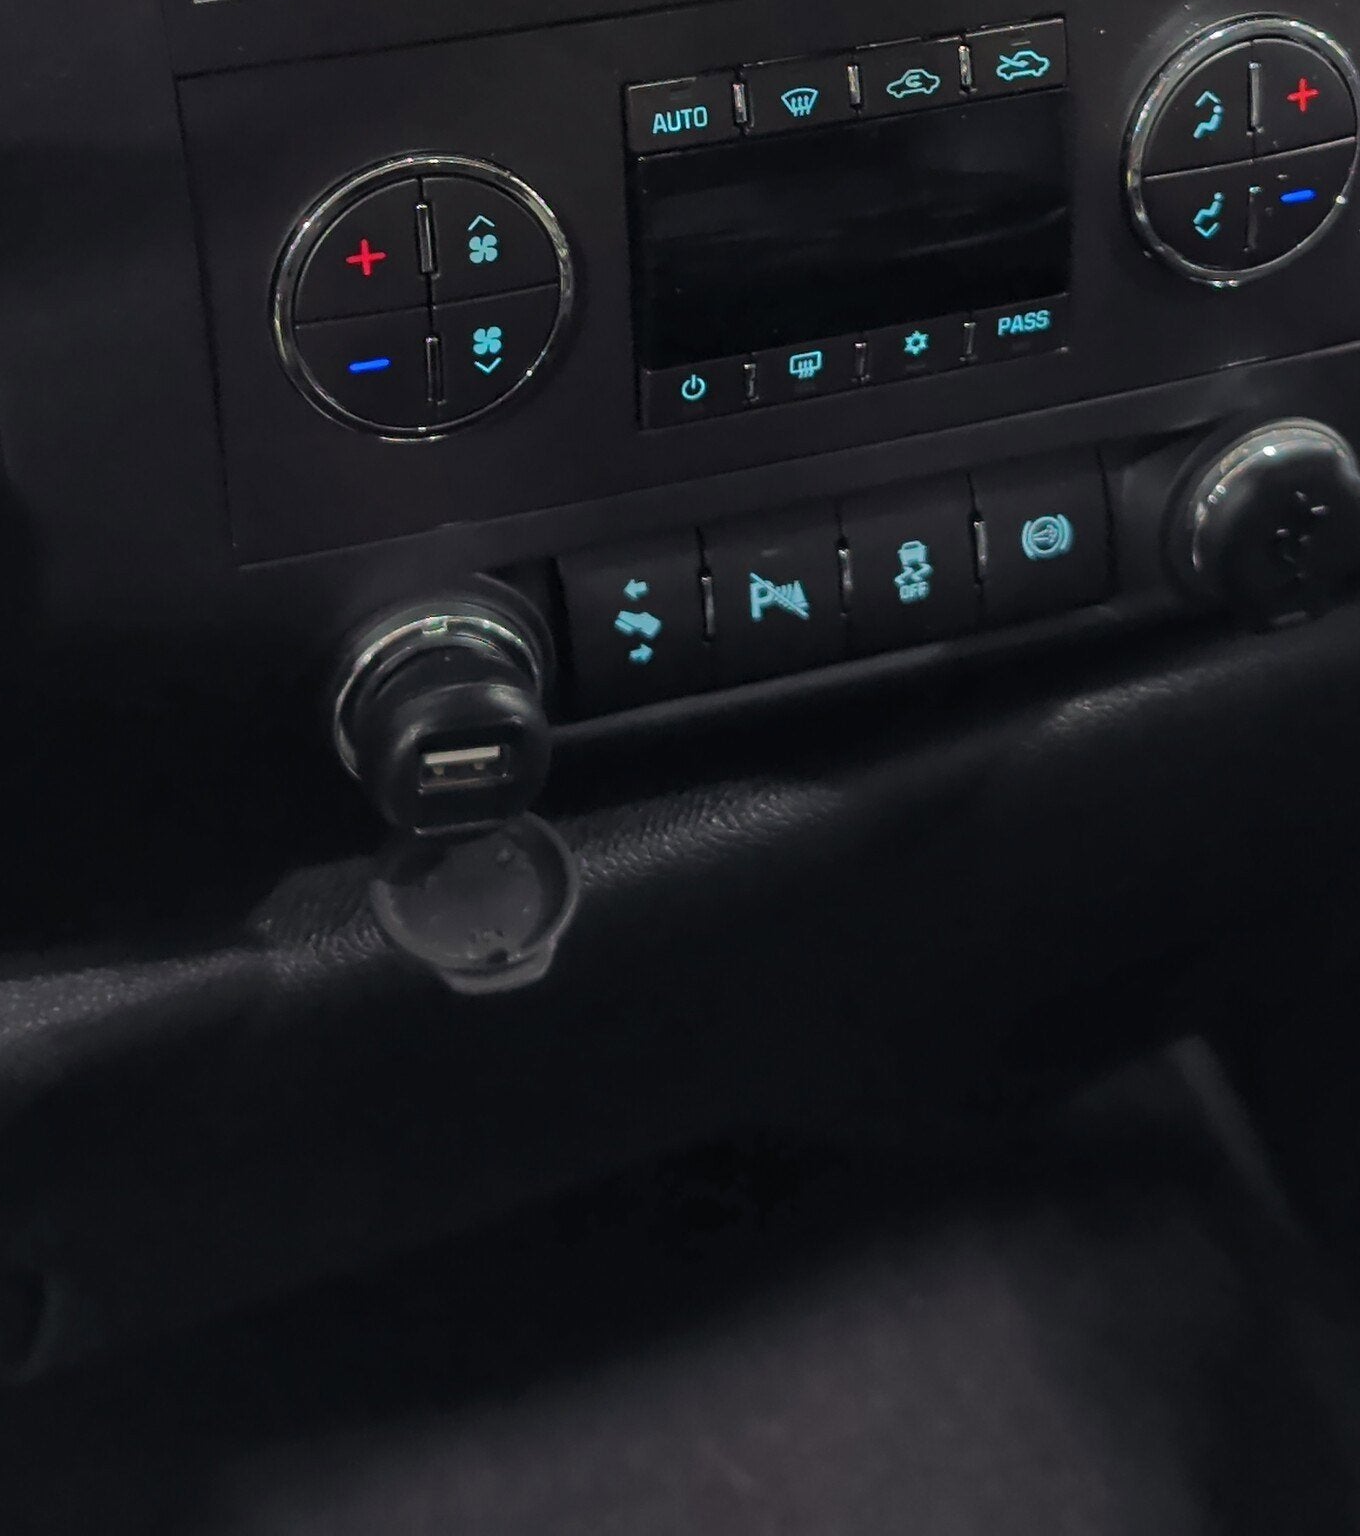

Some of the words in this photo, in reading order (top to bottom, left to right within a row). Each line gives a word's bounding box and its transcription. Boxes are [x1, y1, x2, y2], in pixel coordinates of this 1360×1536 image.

[652, 106, 709, 135] AUTO
[997, 309, 1051, 337] PASS
[899, 581, 930, 602] OFF
